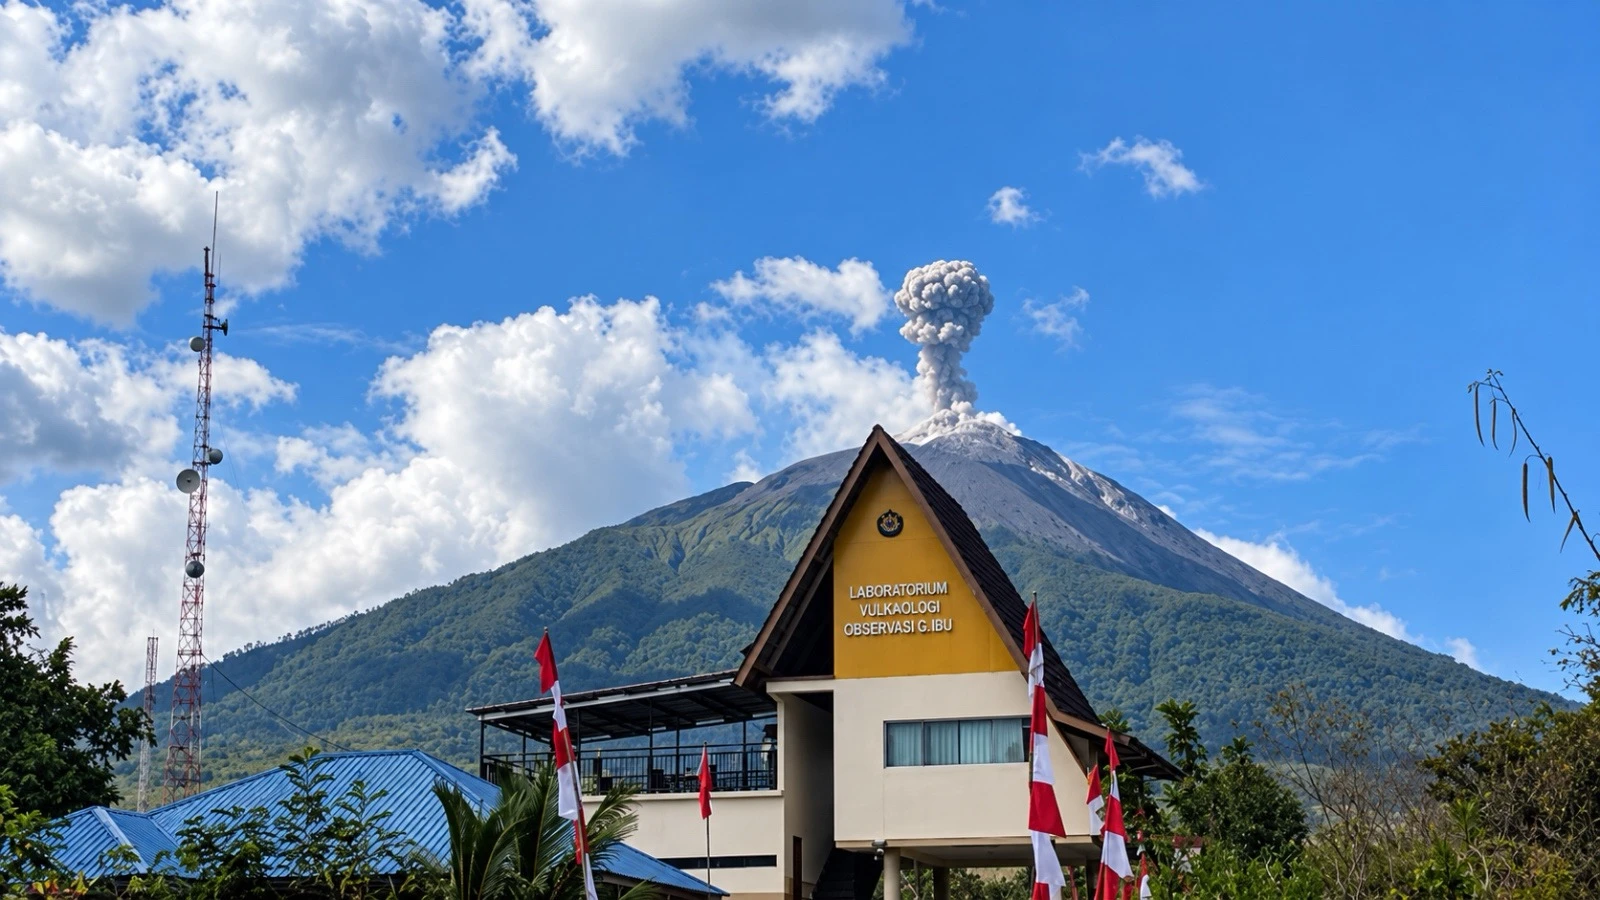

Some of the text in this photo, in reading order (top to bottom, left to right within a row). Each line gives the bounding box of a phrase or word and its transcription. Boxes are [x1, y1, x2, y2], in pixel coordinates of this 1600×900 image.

[850, 582, 948, 599] LABORATORIUM
[860, 601, 940, 617] VULKAOLOGI
[844, 620, 915, 636] OBSERVASI
